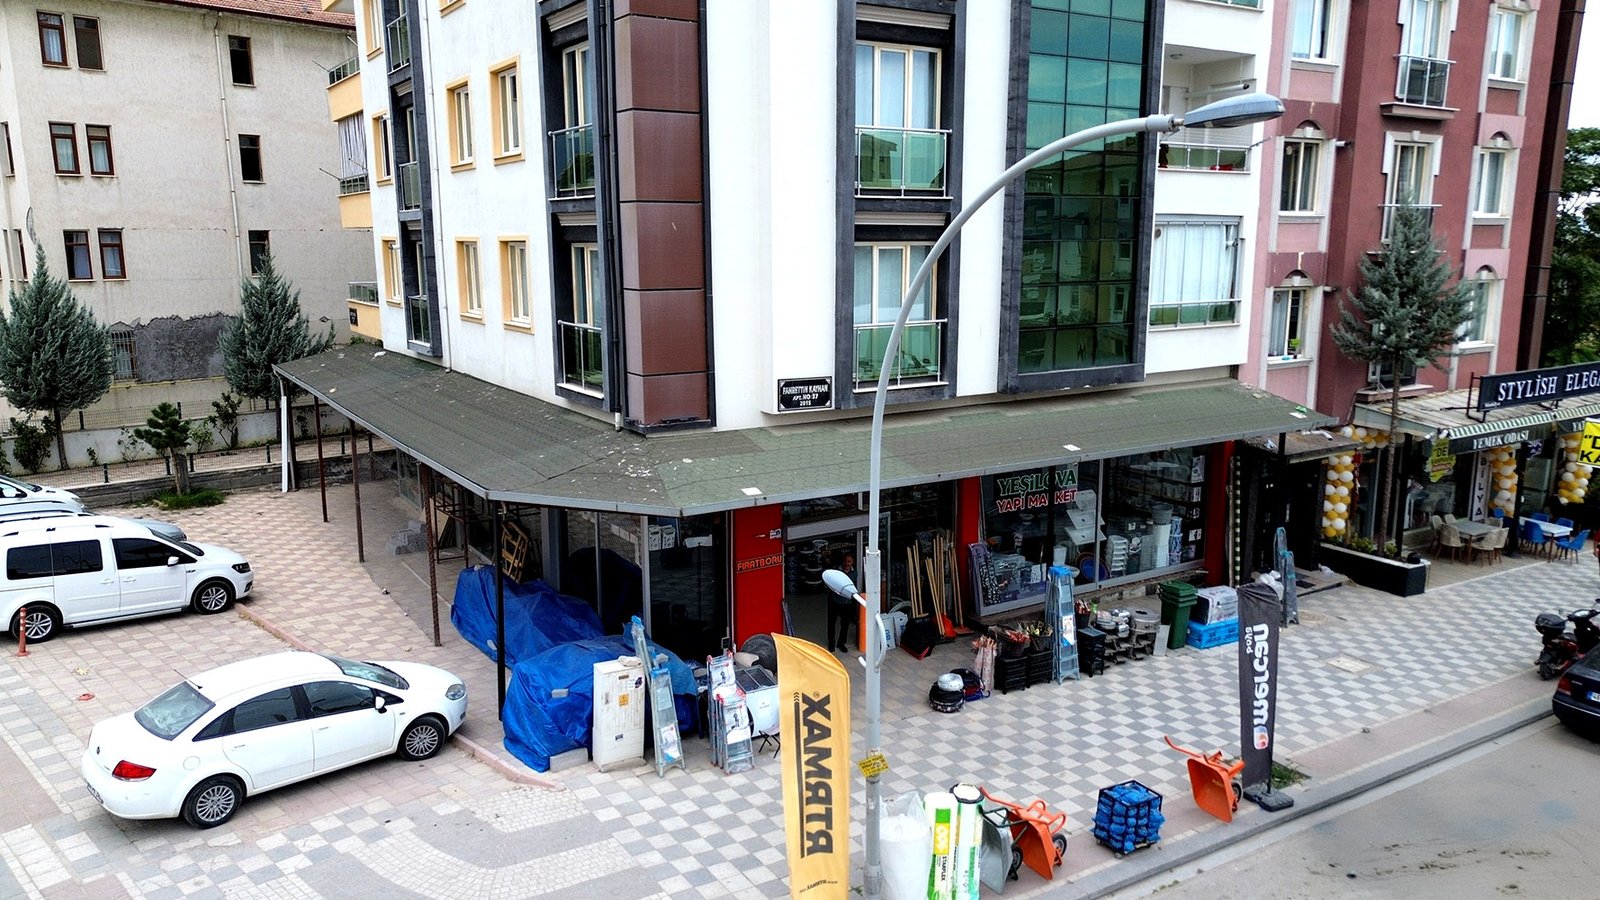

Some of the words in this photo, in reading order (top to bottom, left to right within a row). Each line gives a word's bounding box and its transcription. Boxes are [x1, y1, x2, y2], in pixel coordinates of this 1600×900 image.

[809, 384, 828, 393] KAYHAN
[1498, 375, 1558, 401] STYLİSH
[1473, 434, 1503, 450] YEMEK
[1027, 488, 1078, 509] MAKET
[737, 555, 782, 571] FIRATBORU
